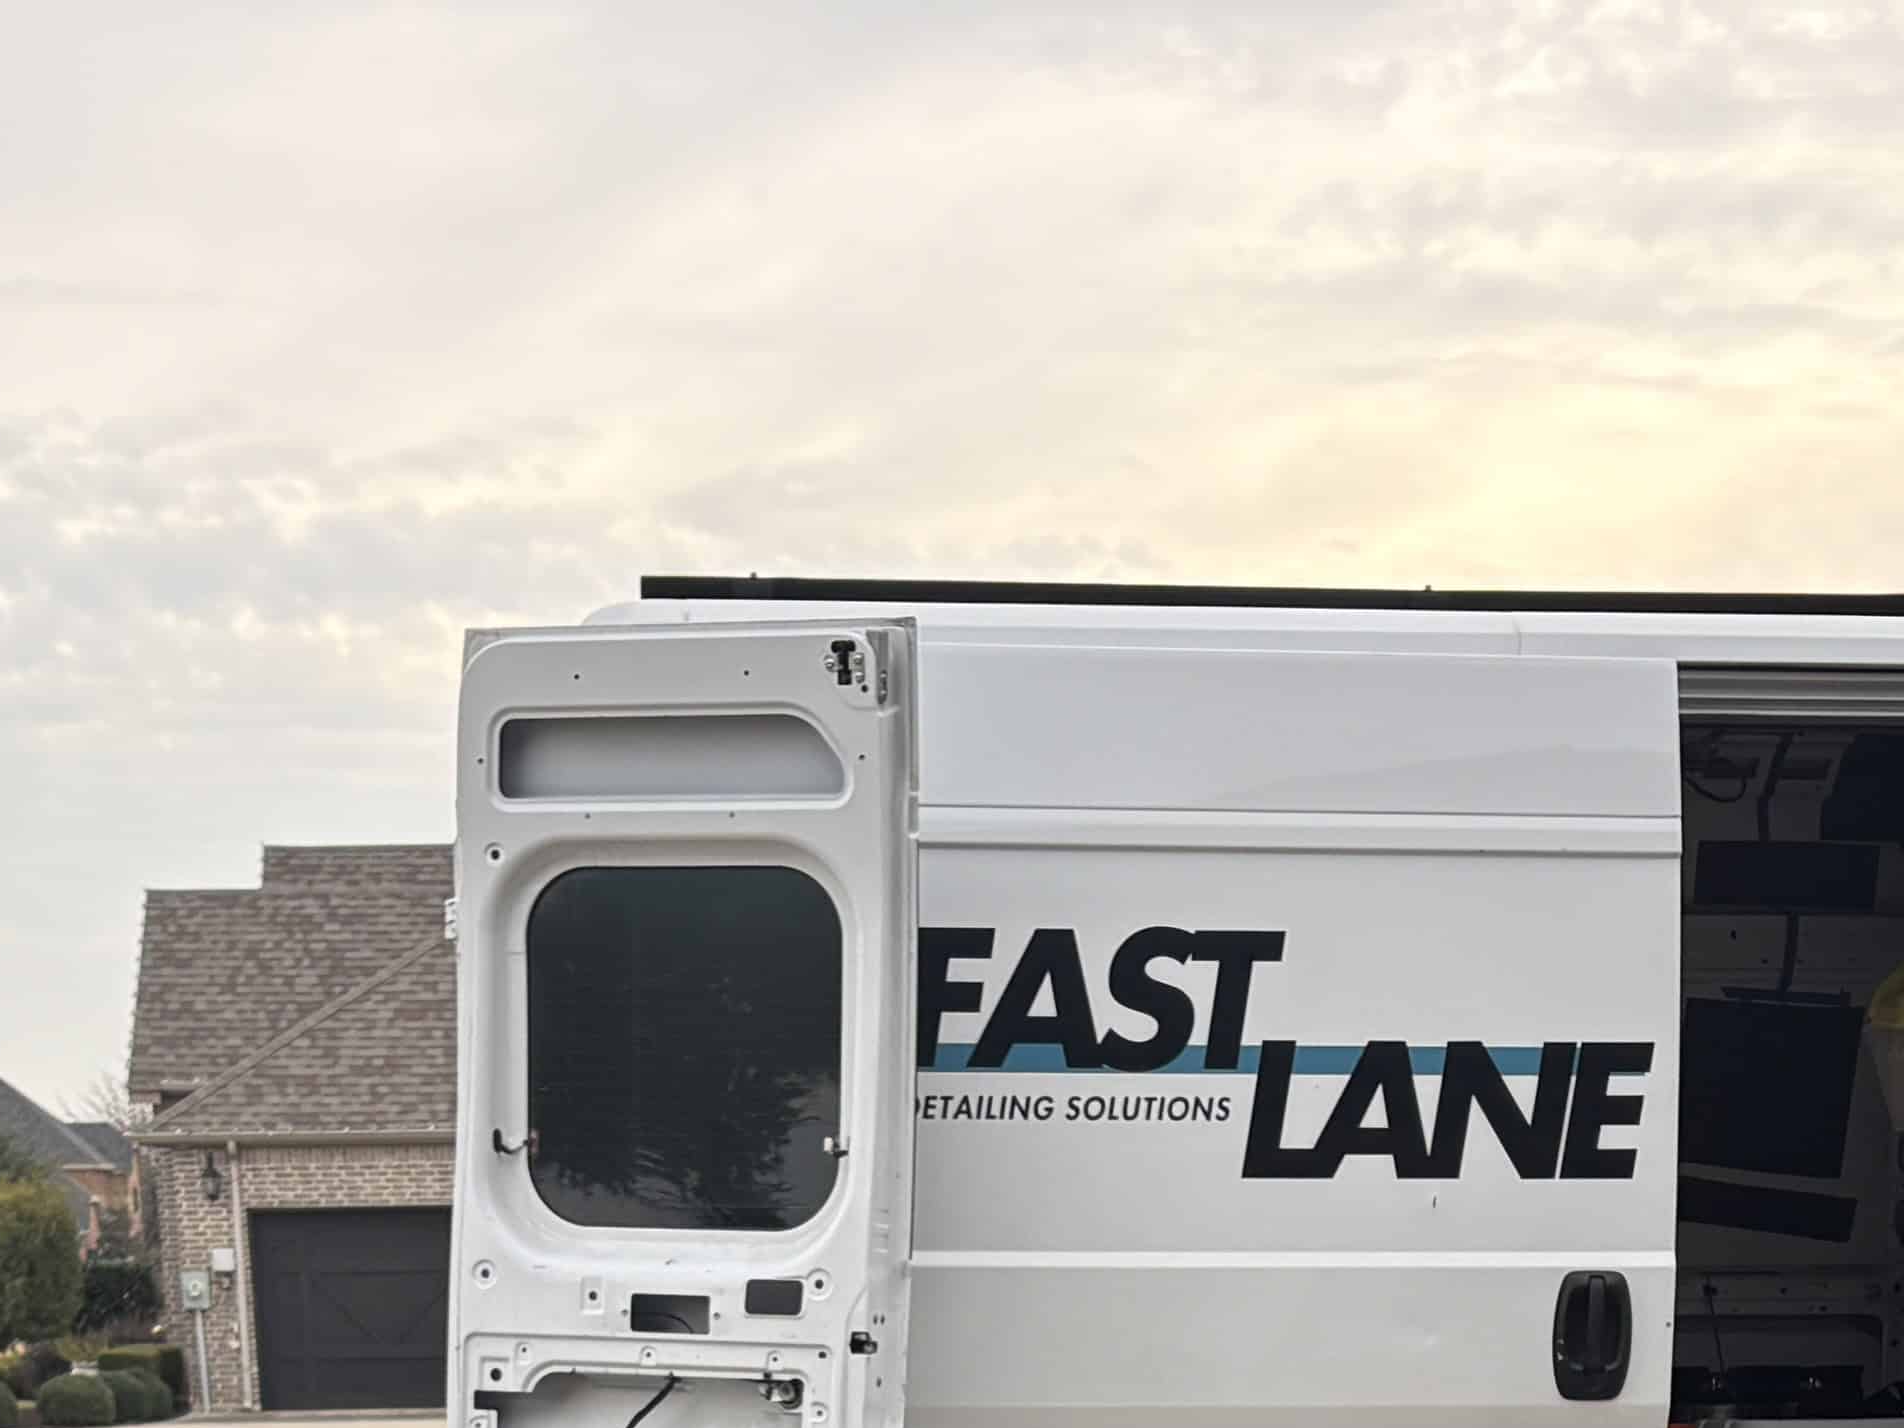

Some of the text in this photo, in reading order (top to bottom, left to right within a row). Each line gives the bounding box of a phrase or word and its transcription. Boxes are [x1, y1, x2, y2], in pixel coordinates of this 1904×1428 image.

[917, 925, 1287, 1073] FAST
[916, 1094, 1232, 1122] ETAILING SOLUTIONS
[1241, 1039, 1656, 1180] LANE
